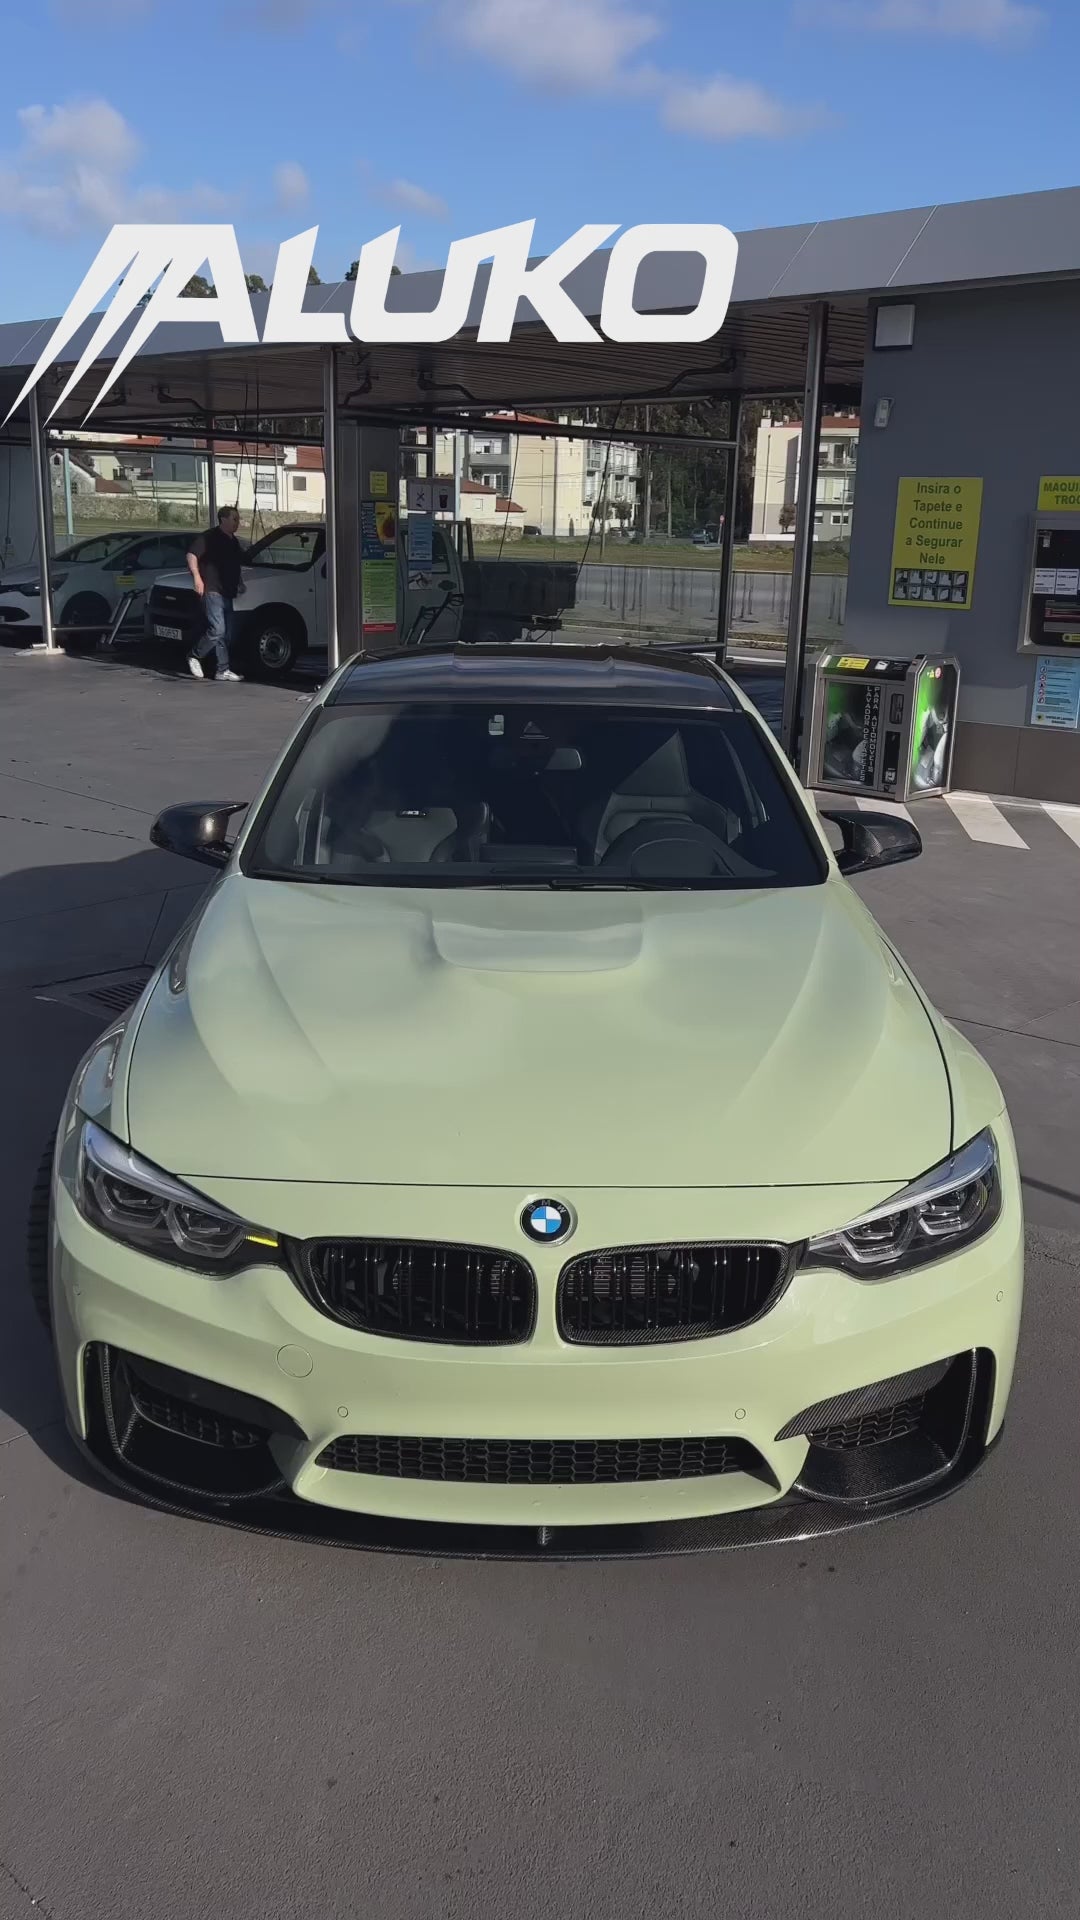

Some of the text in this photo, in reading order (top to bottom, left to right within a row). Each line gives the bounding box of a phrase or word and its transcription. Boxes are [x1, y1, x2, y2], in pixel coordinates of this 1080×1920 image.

[917, 482, 961, 494] Insira o
[913, 499, 963, 514] Tapete e
[909, 517, 963, 529] Continue
[905, 534, 964, 549] a Segurar
[919, 552, 945, 565] Nele
[528, 1199, 567, 1214] BMW
